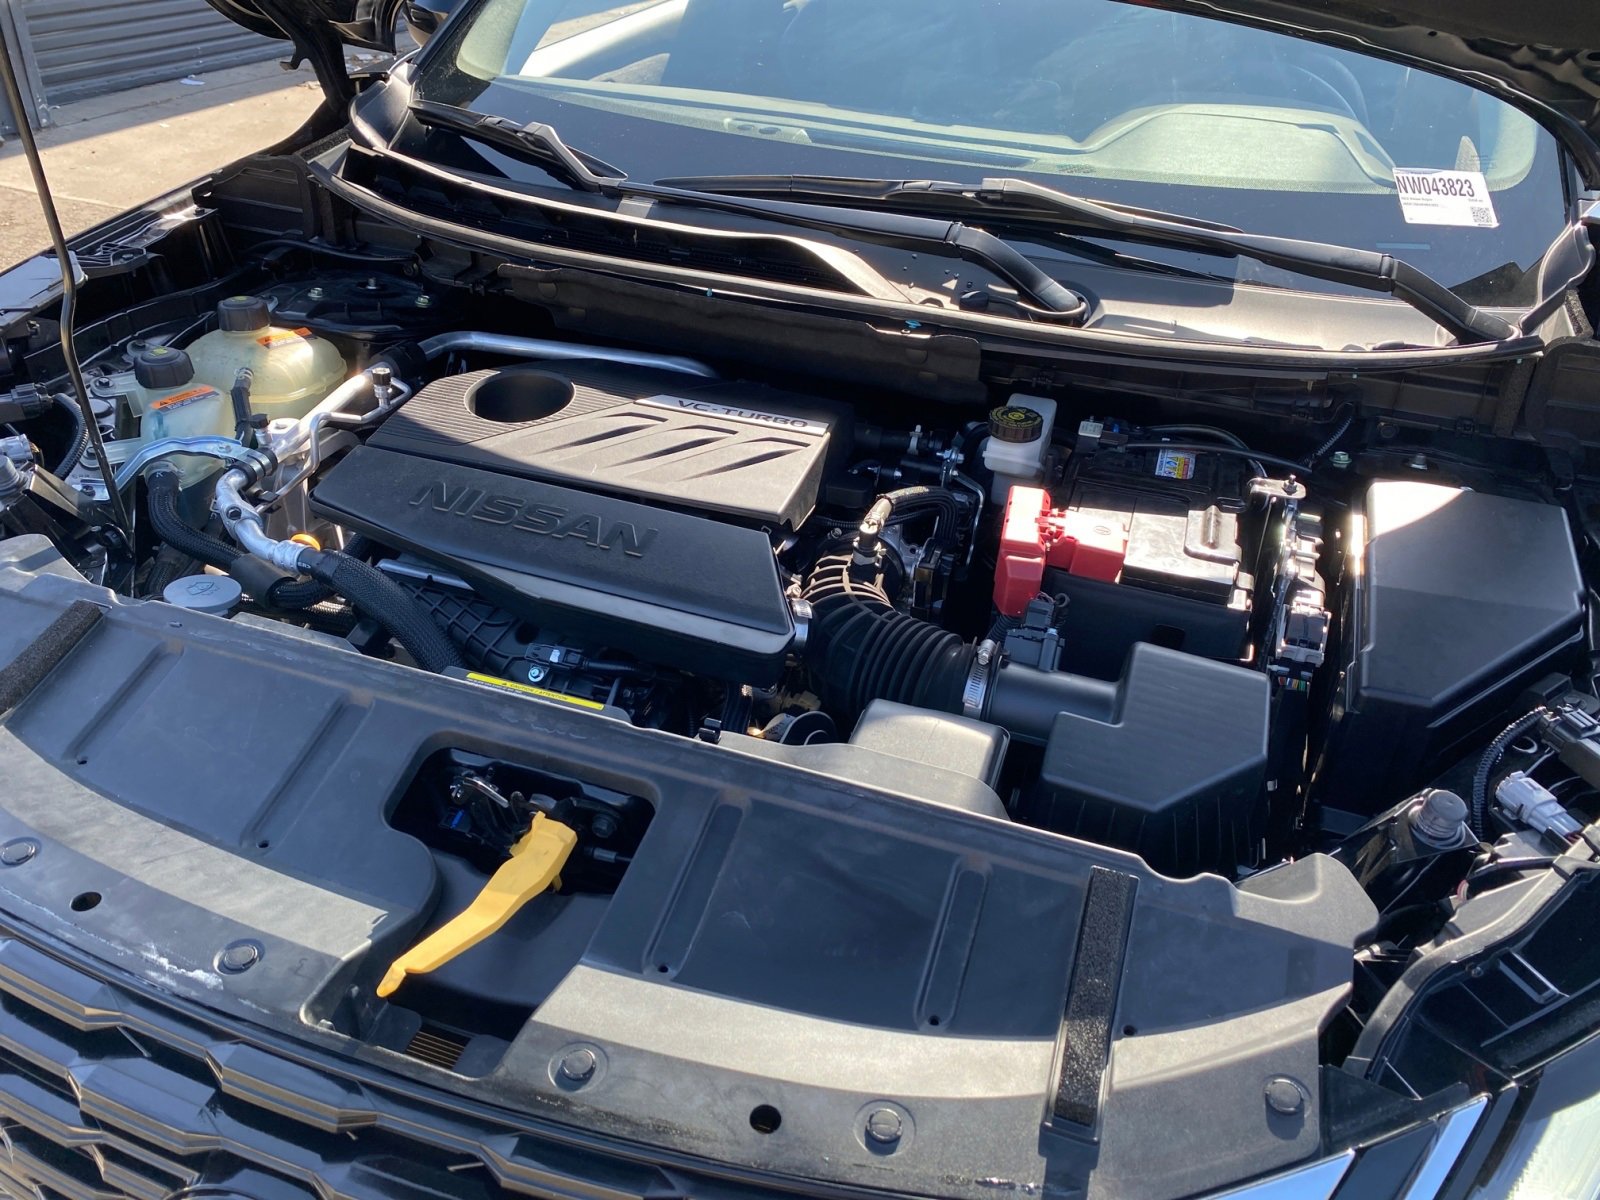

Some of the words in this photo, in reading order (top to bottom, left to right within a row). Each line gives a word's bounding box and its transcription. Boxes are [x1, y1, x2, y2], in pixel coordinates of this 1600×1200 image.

[1395, 175, 1475, 197] NW043823
[678, 399, 808, 428] VC-TURBO
[408, 482, 659, 557] NISSAN
